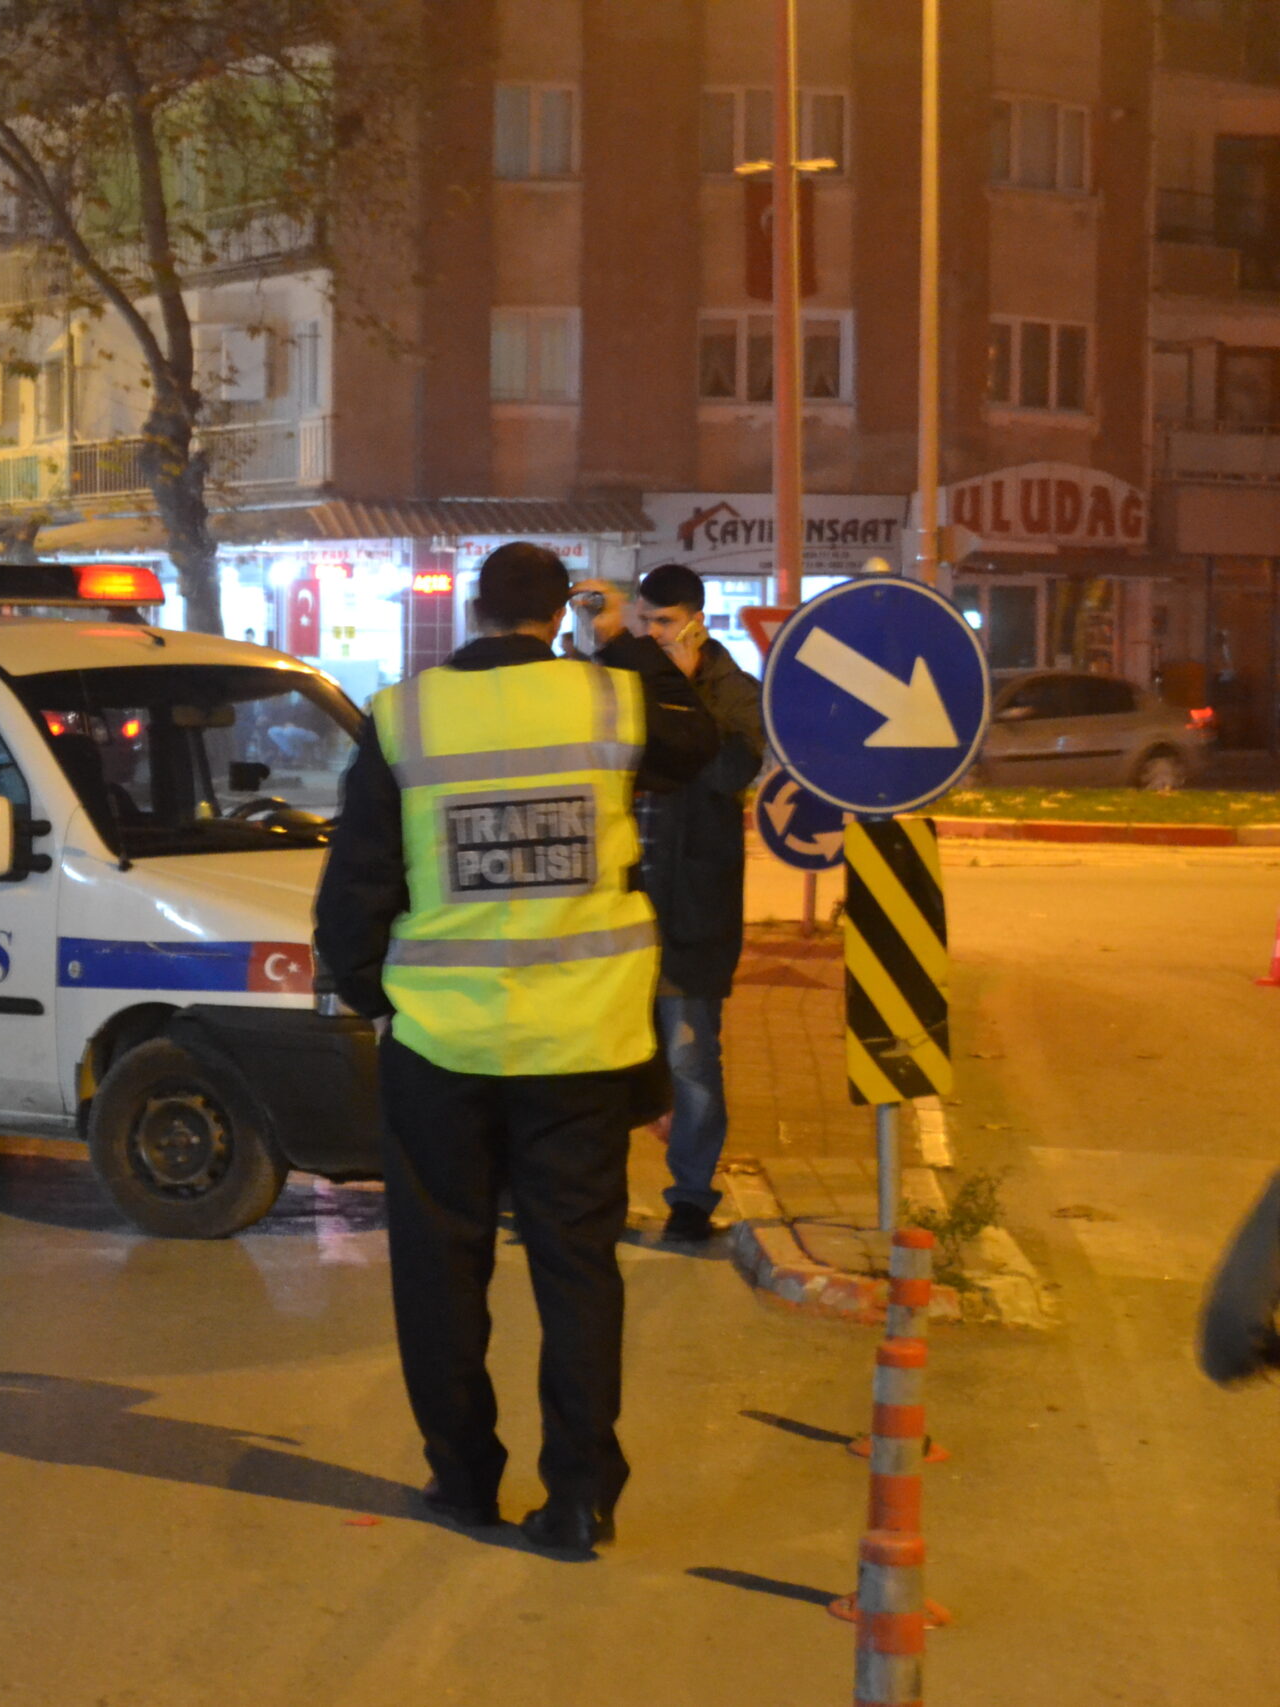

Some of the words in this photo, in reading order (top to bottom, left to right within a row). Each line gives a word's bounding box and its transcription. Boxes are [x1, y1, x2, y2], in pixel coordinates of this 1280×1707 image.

[952, 478, 1145, 538] ULUDAĞ
[800, 517, 898, 550] NŞAAT
[449, 800, 586, 845] TRAFİK
[456, 842, 584, 887] POLİSİ
